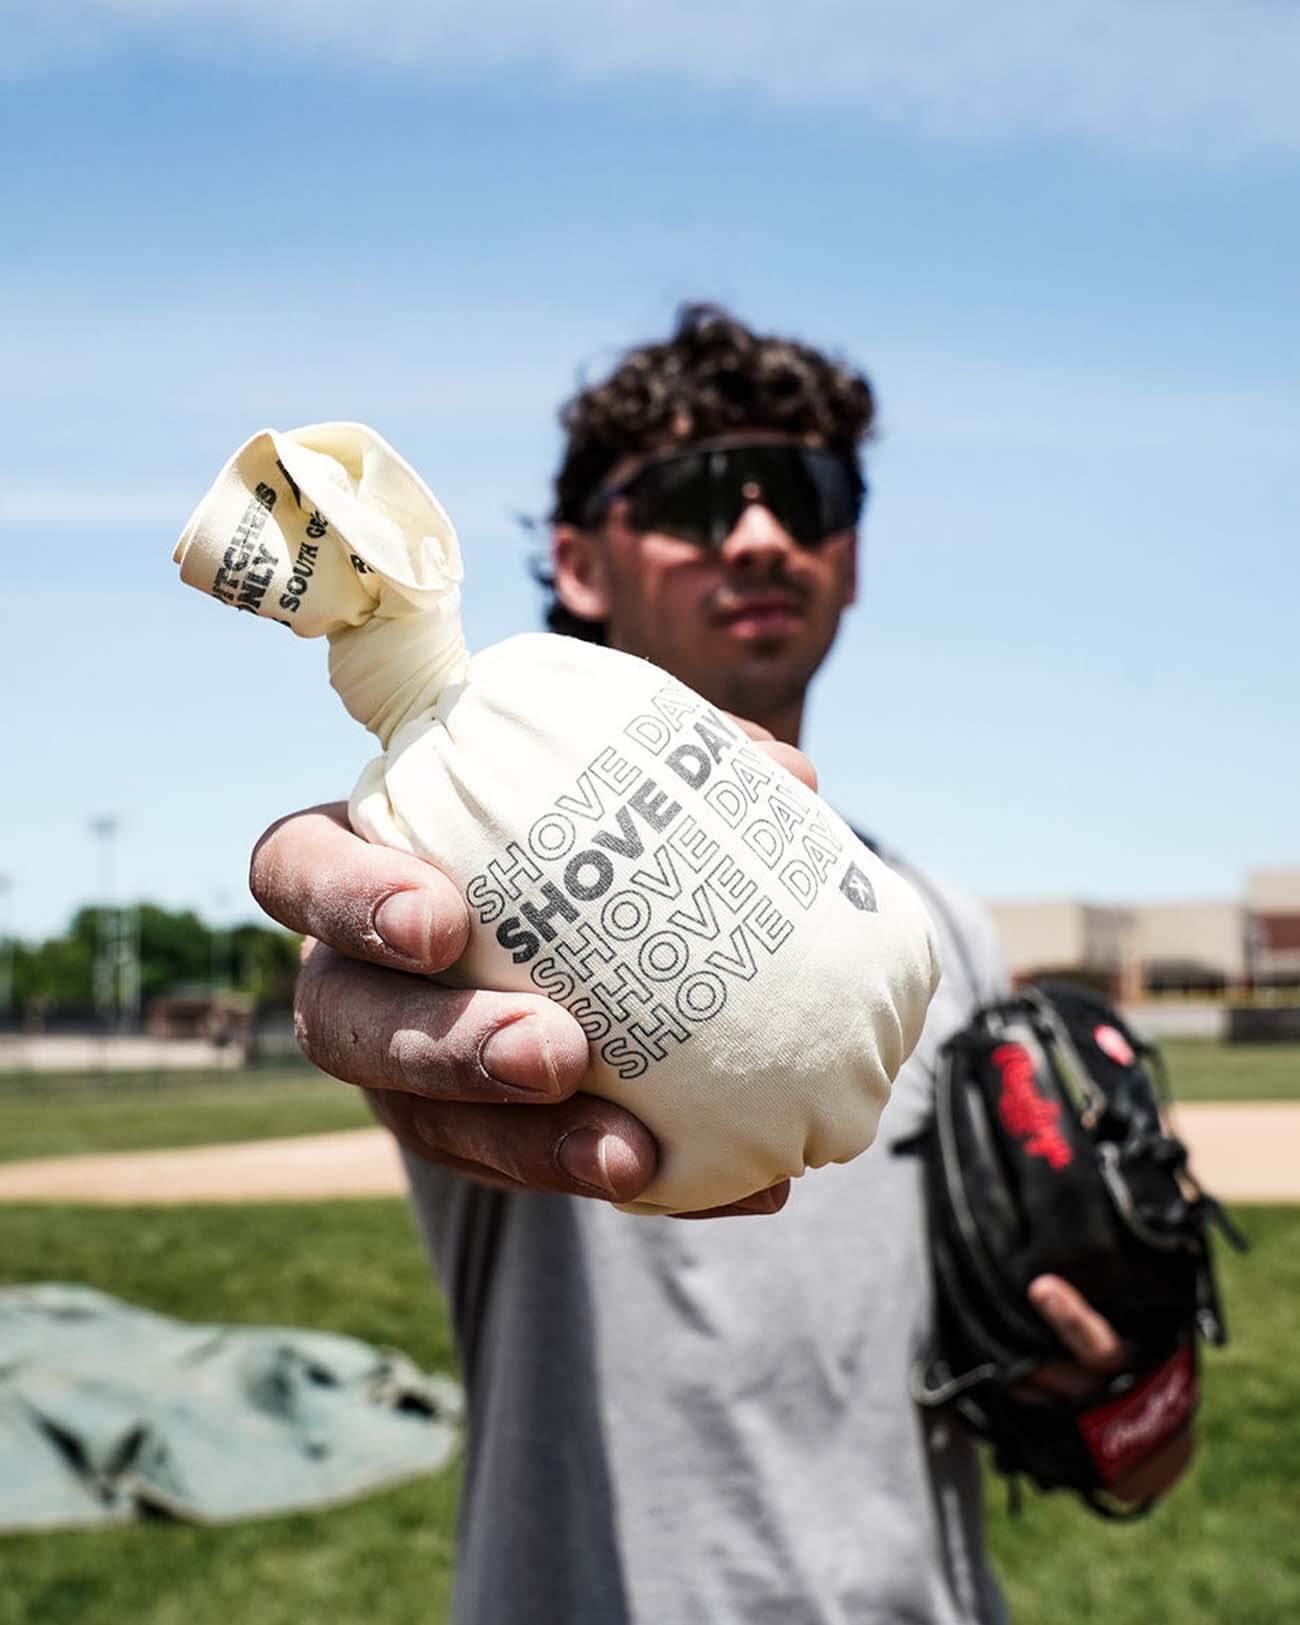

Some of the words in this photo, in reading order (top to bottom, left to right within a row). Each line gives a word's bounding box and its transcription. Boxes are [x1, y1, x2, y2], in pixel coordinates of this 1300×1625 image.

[280, 541, 318, 612] SOUTH
[465, 746, 642, 924] SHOVE
[496, 779, 682, 964] SHOVE
[664, 708, 738, 791] DAY
[530, 815, 719, 1001] SHOVE
[569, 856, 758, 1041] SHOVE
[602, 895, 794, 1080] SHOVE
[778, 811, 843, 910] DAY
